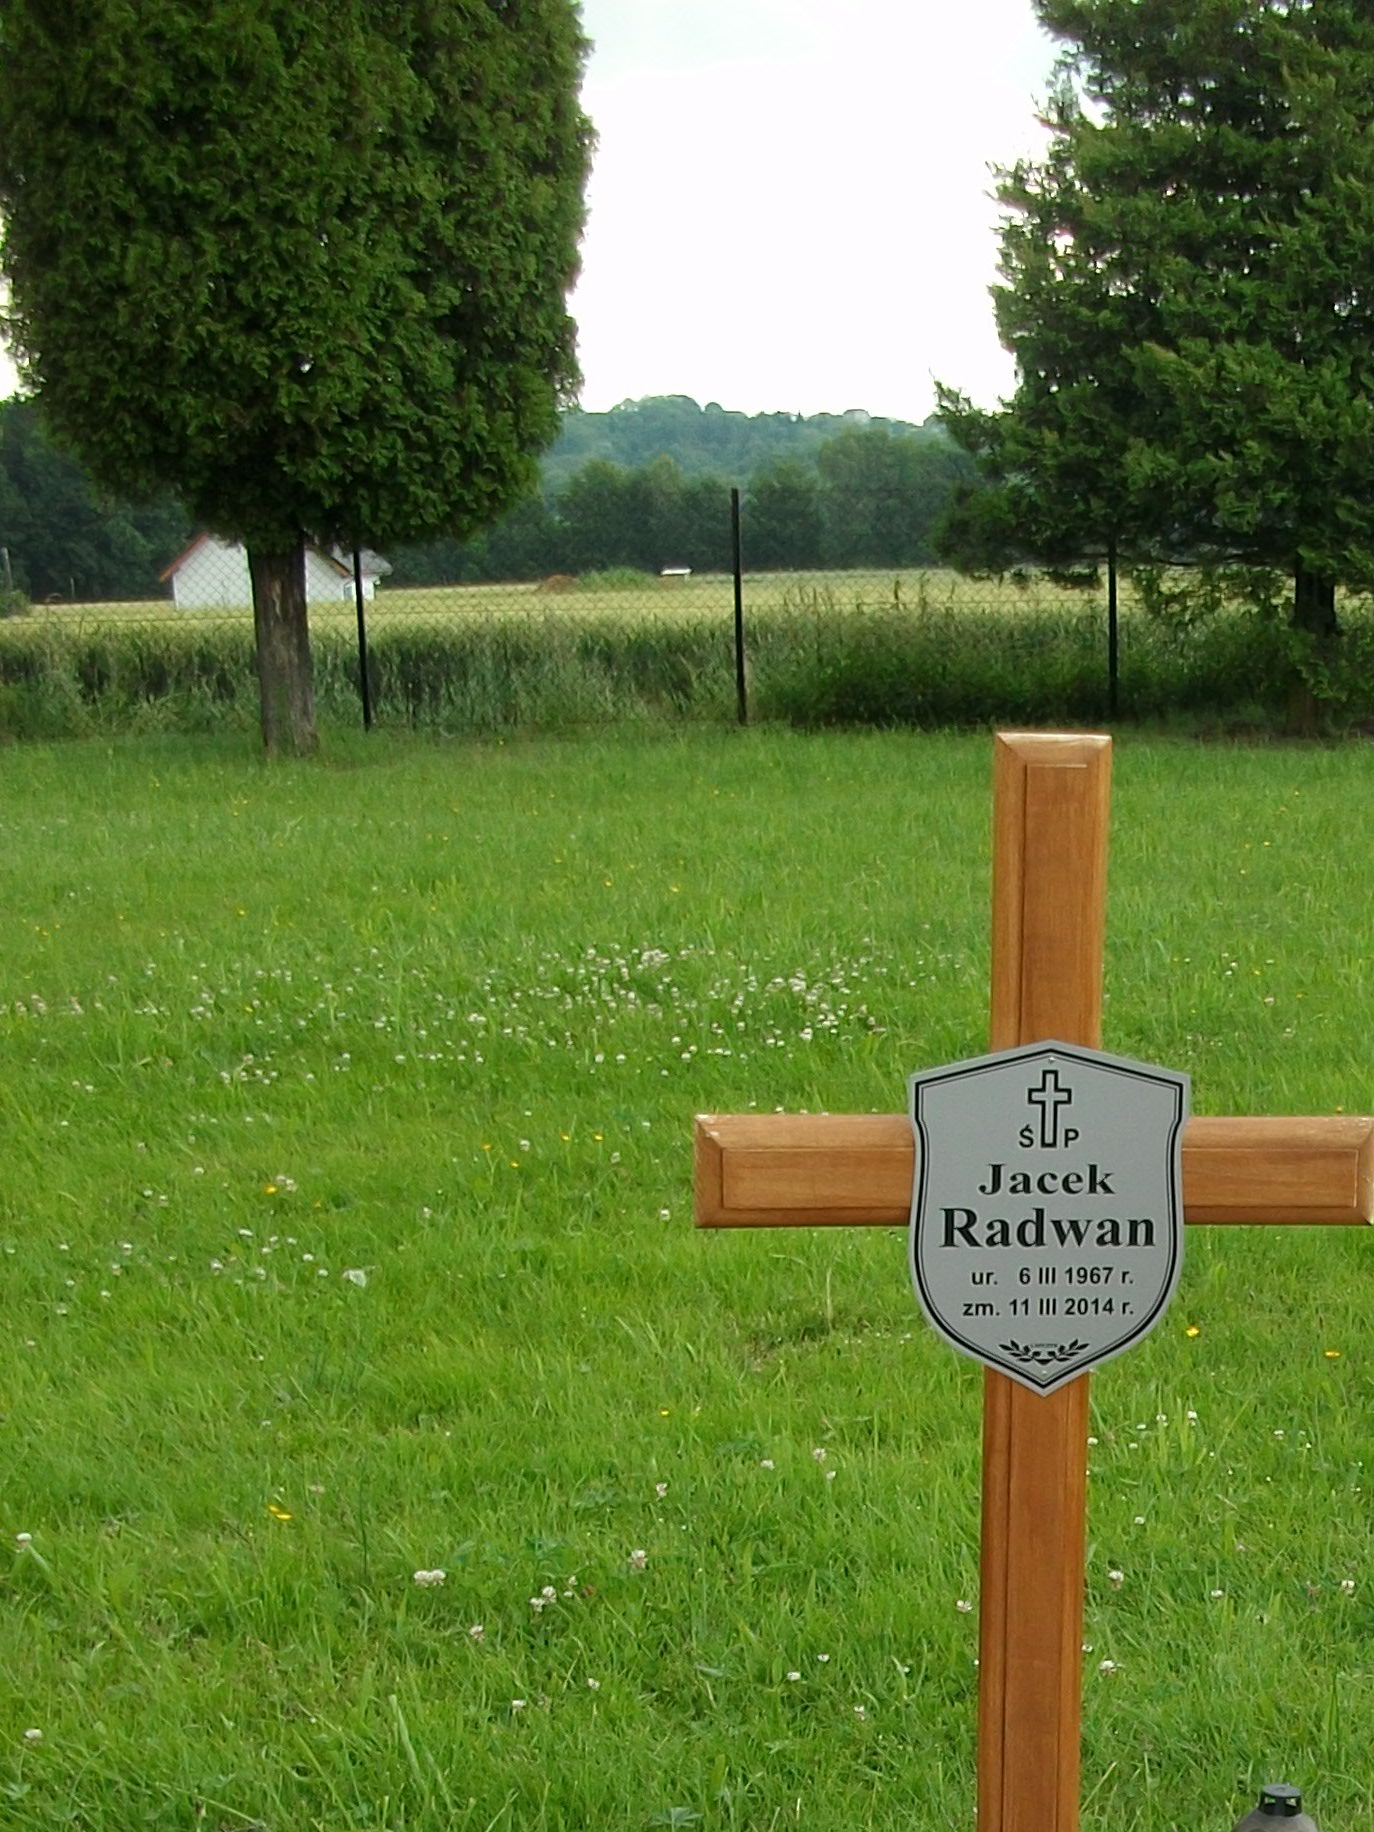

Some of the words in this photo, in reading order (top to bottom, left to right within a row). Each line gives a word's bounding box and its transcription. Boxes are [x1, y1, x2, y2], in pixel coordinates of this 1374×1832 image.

[1018, 1123, 1035, 1149] Ś
[1063, 1127, 1080, 1149] P
[978, 1163, 1116, 1196] Jacek
[938, 1207, 1156, 1248] Radwan
[971, 1271, 998, 1286] ur.
[1018, 1266, 1031, 1286] 6
[1038, 1266, 1057, 1285] III
[1064, 1266, 1114, 1285] 1967
[1121, 1270, 1134, 1285] r.
[962, 1302, 1001, 1317] zm.
[1008, 1297, 1029, 1316] 11
[1039, 1297, 1057, 1316] III
[1064, 1297, 1115, 1316] 2014
[1121, 1301, 1134, 1316] r.
